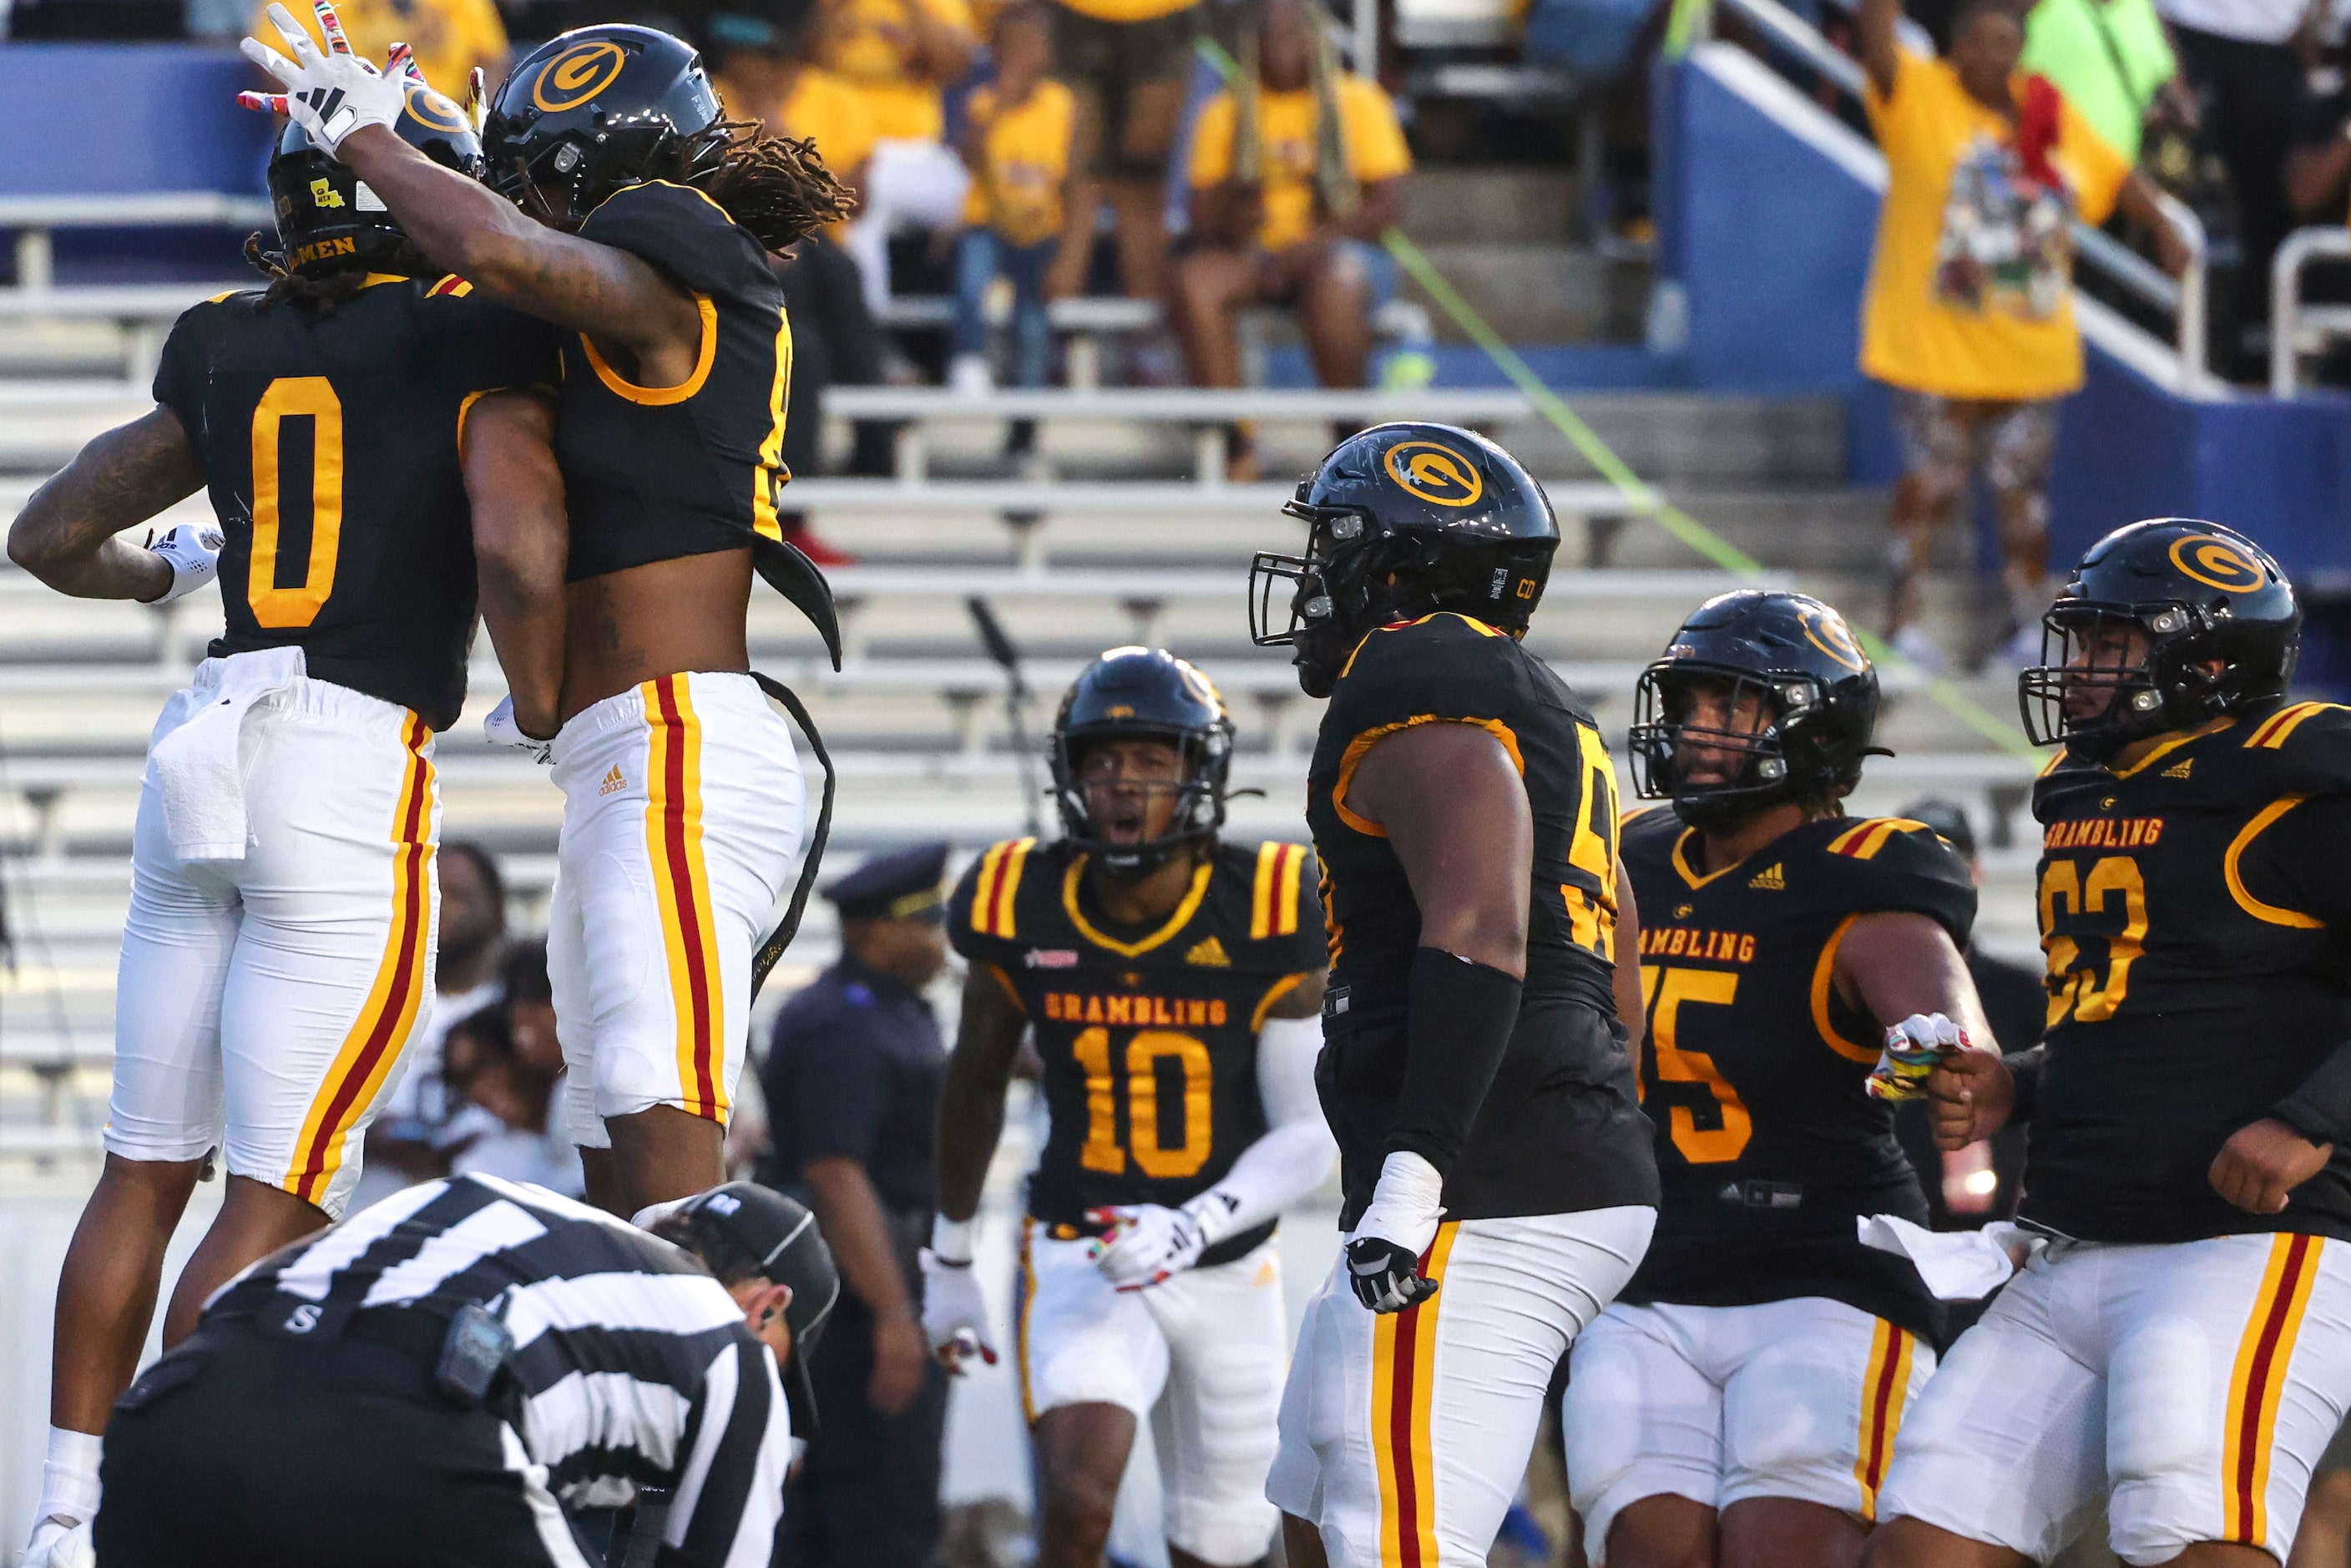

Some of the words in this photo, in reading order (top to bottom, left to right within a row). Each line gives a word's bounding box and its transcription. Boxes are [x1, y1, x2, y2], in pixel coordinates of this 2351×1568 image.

[247, 376, 343, 628] 0
[2044, 817, 2165, 851] GRAMBLING
[2040, 855, 2149, 1032] 63
[1044, 991, 1228, 1027] GRAMBLING
[1072, 1025, 1213, 1179] 10
[284, 1303, 322, 1334] S
